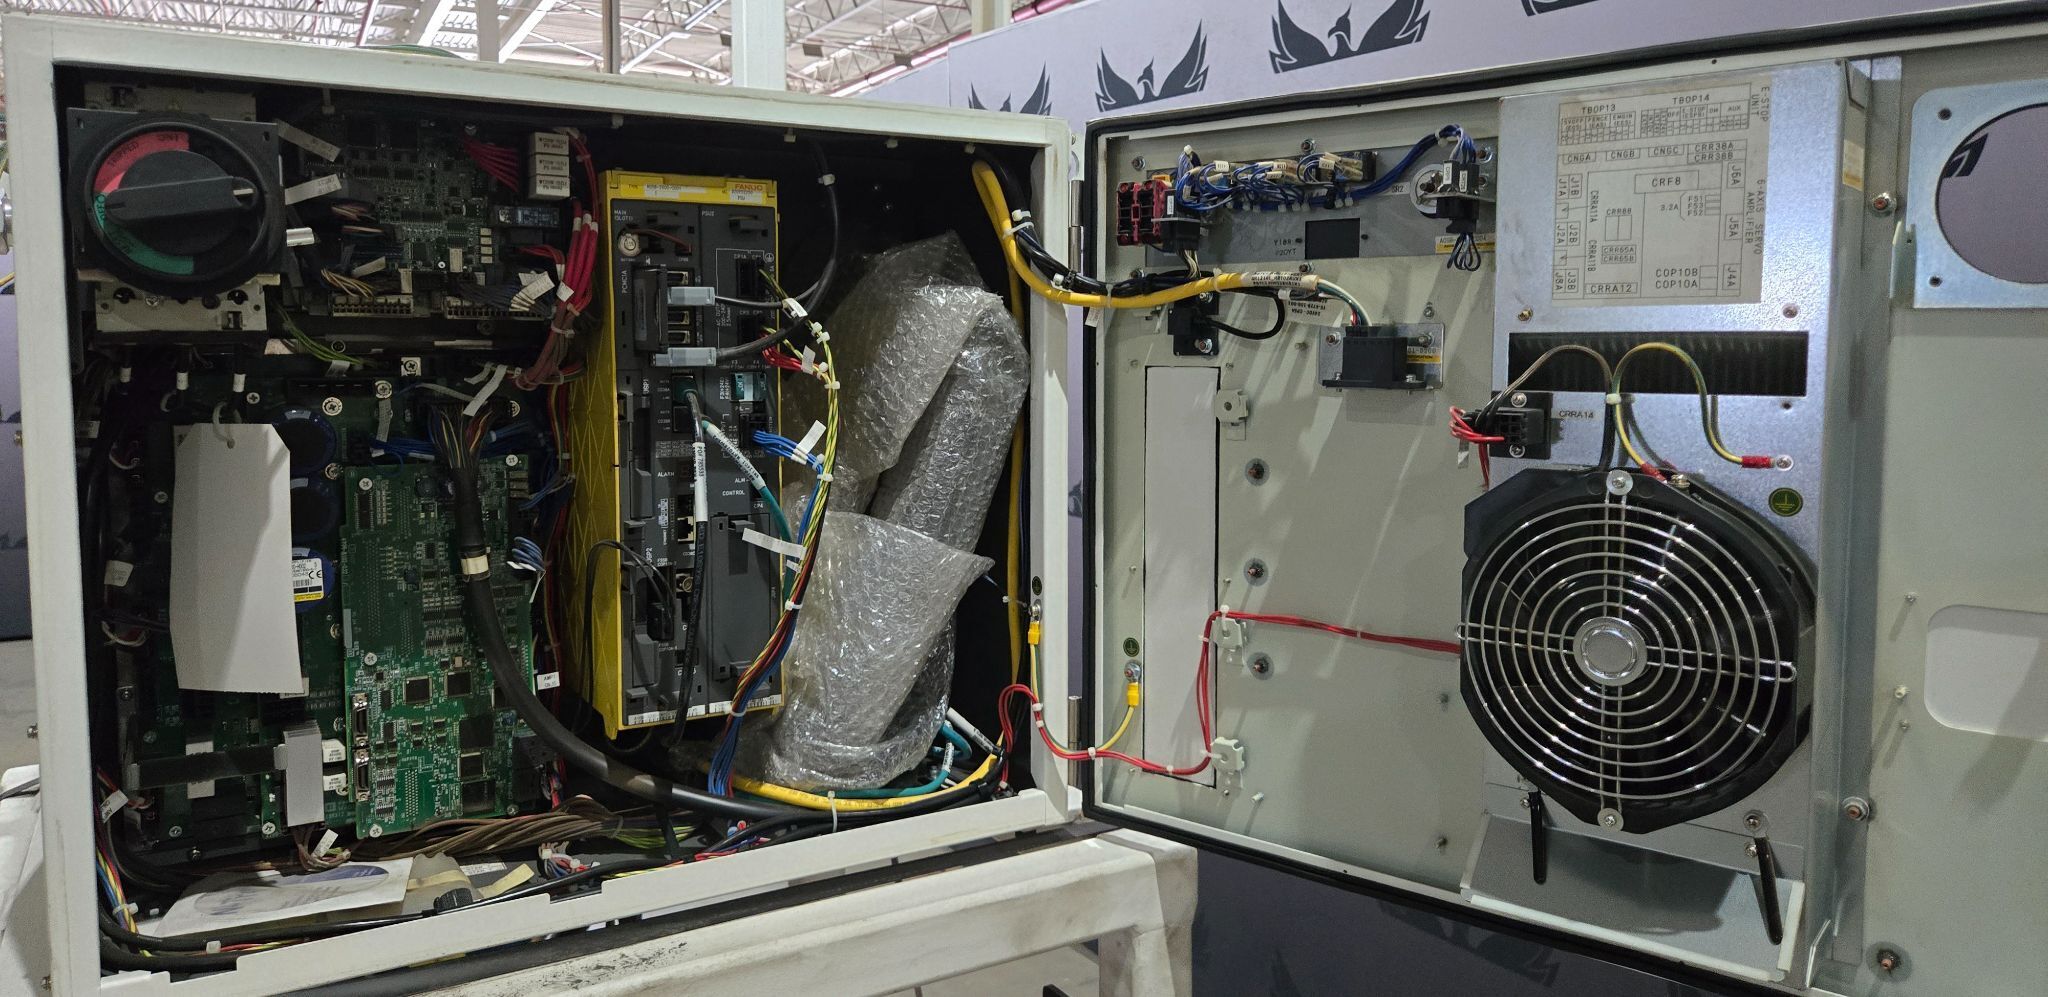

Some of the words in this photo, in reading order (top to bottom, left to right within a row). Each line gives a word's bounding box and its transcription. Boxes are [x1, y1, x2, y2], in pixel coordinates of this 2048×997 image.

[1672, 94, 1710, 105] TBOP14
[1751, 94, 1760, 116] UNIT
[1761, 86, 1770, 122] E-STOP
[1582, 103, 1616, 114] TBOP13
[1653, 146, 1679, 155] CNGC
[1694, 142, 1734, 152] CRR38A
[1567, 153, 1591, 163] CNGA
[1610, 150, 1635, 160] CNGB
[734, 183, 763, 192] FANUC
[1558, 178, 1567, 197] J1A
[1570, 177, 1580, 196] J1B
[1651, 177, 1681, 187] CRF8
[1756, 179, 1766, 213] 6-AXIS
[1744, 192, 1755, 244] AMPLIFIER
[1569, 224, 1579, 244] J2B
[1728, 216, 1739, 237] J5A
[1556, 225, 1566, 244] J2A
[1753, 224, 1764, 255] SERVO
[1655, 268, 1698, 277] COP10B
[1727, 266, 1737, 287] J4A
[1567, 271, 1577, 290] J3B
[1655, 279, 1698, 289] COP10A
[1590, 284, 1632, 294] CRRA12
[722, 489, 745, 497] CONTROL
